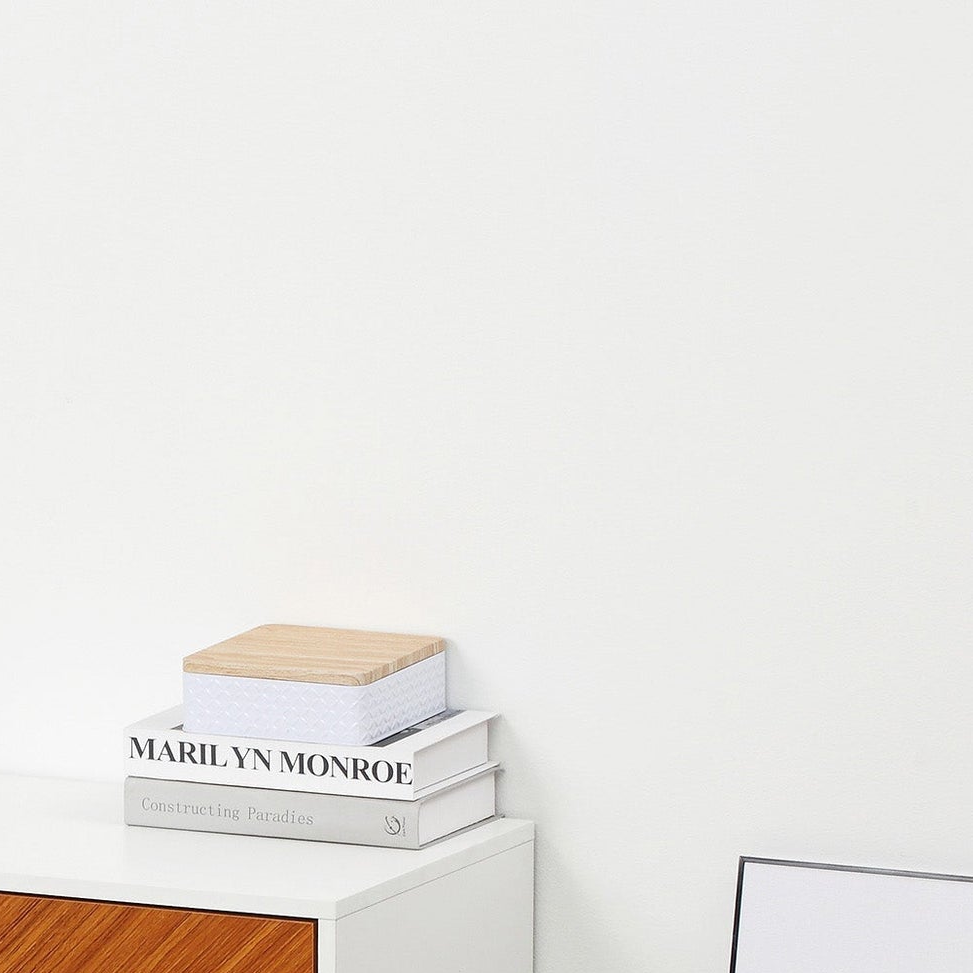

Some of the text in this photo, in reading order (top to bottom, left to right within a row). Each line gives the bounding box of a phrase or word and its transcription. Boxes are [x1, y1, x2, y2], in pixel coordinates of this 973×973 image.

[129, 736, 413, 785] MARILYN MONROE
[141, 797, 315, 826] Constructing Paradies
